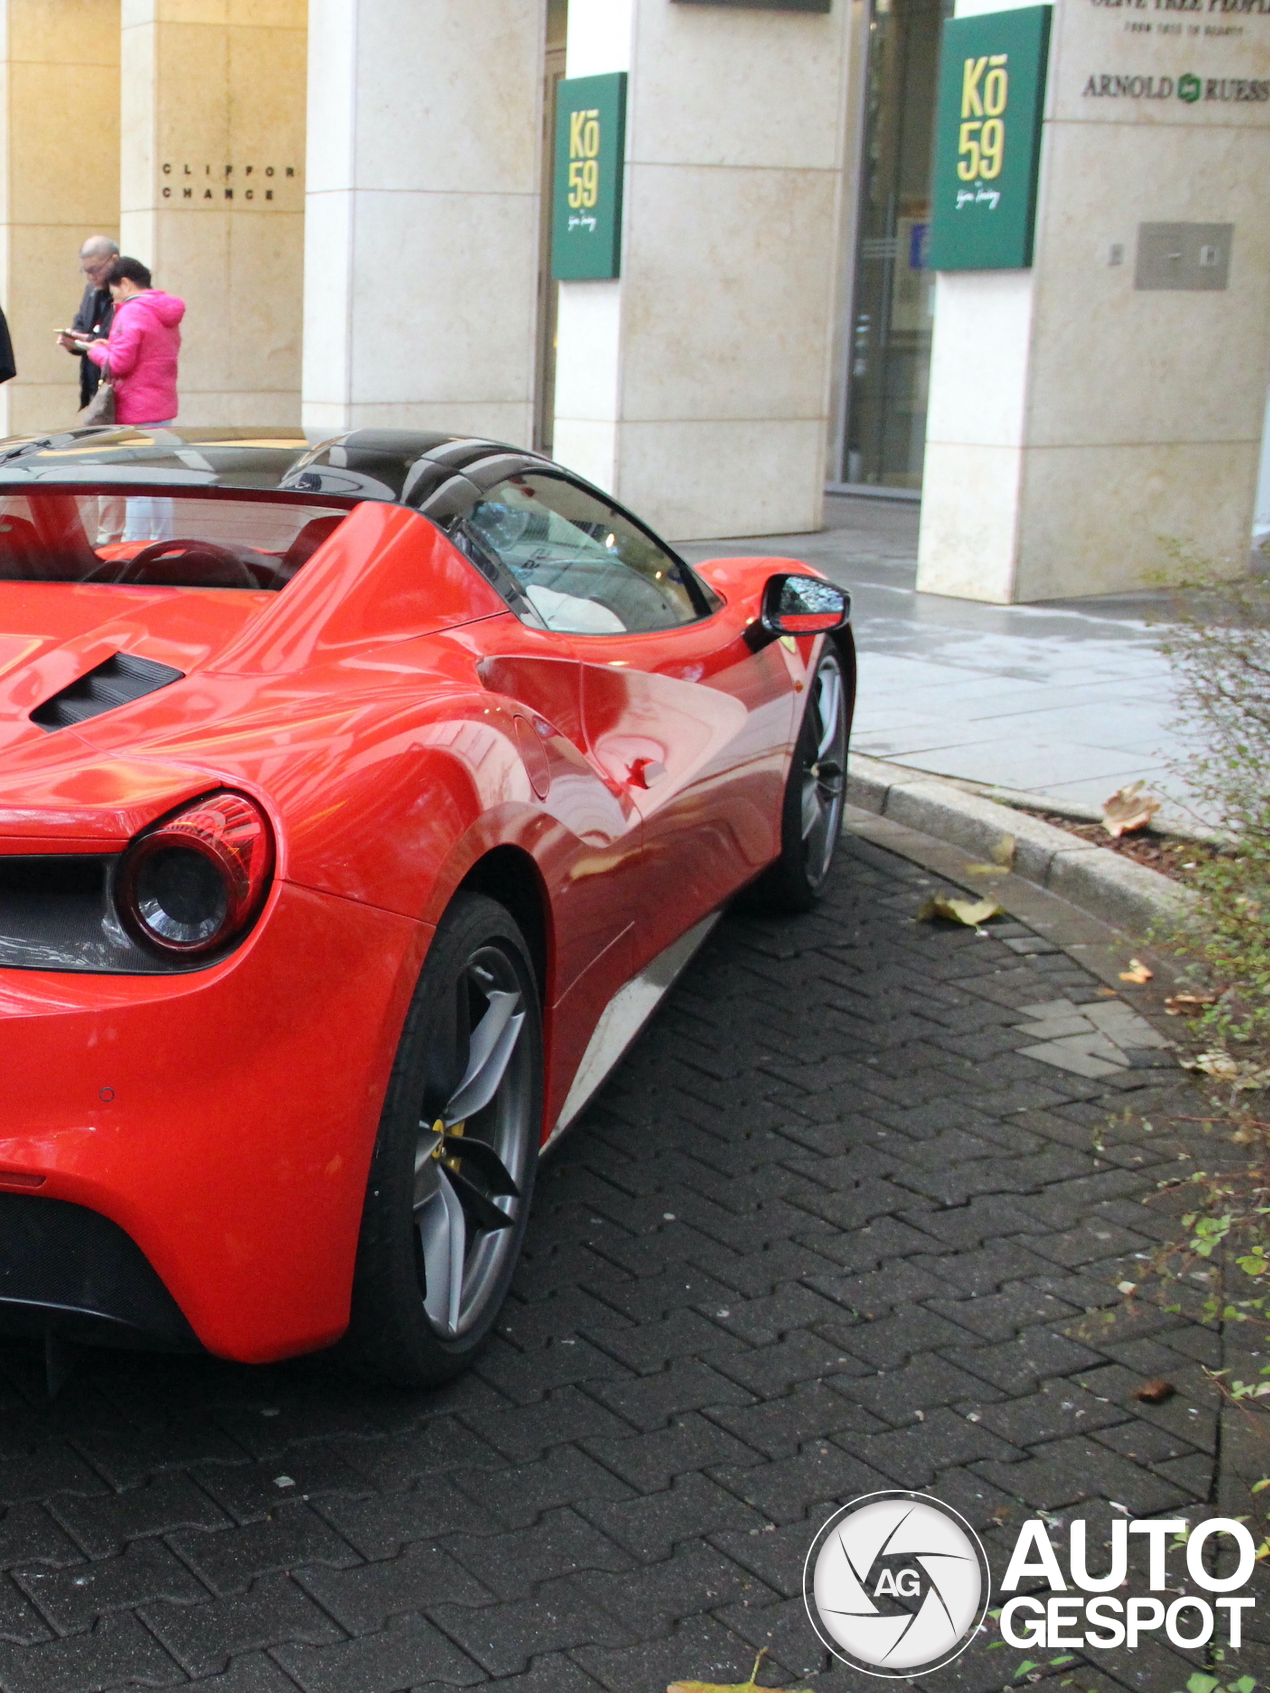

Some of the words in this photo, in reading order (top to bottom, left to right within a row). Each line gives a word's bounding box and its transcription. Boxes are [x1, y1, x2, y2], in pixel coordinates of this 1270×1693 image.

[1083, 73, 1174, 99] ARNOLD
[1205, 78, 1270, 102] RUESS
[957, 118, 1005, 181] 59
[162, 187, 273, 201] CHANCE
[568, 159, 599, 209] 59
